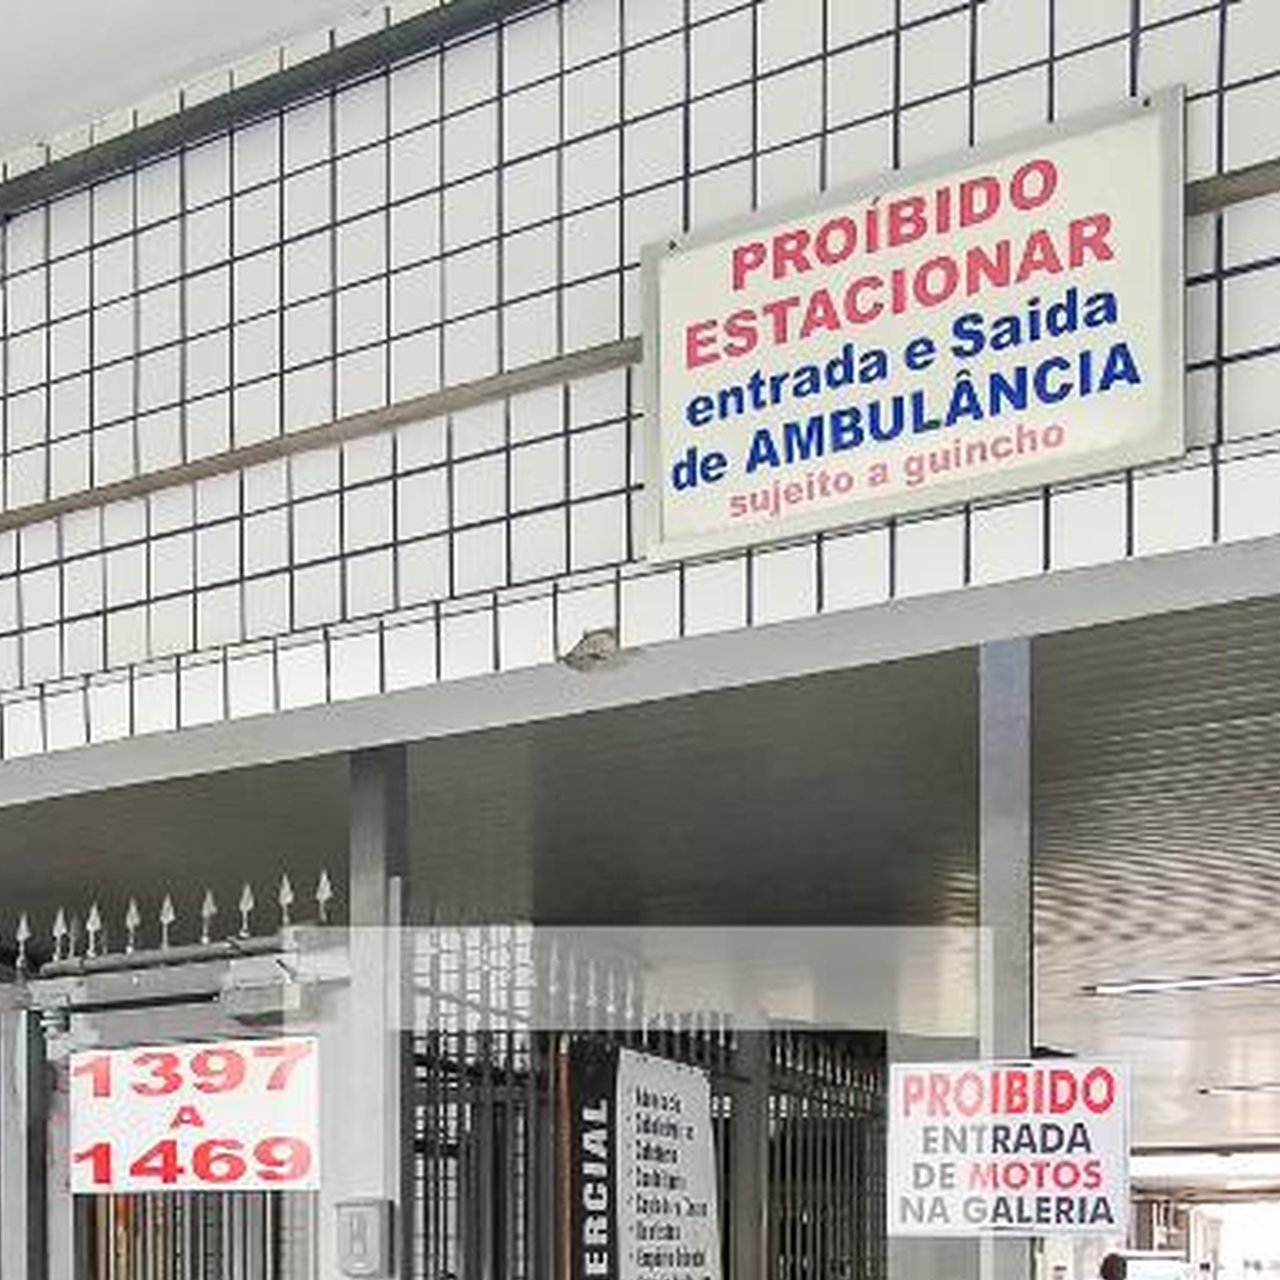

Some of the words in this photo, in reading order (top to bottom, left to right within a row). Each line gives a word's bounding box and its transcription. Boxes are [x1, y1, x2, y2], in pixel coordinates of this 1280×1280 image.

[731, 158, 1059, 290] PROÍBIDO
[684, 212, 1116, 368] ESTACIONAR
[685, 342, 888, 427] entrada
[904, 336, 937, 371] e
[950, 287, 1118, 358] Saida
[671, 447, 727, 491] de
[745, 342, 1142, 473] AMBULÂNCIA
[728, 458, 854, 519] sujeito
[866, 465, 890, 487] a
[903, 422, 1065, 486] guincho
[73, 1044, 313, 1098] 1397
[902, 1066, 1115, 1117] PROIBIDO
[170, 1105, 205, 1129] A
[922, 1122, 1091, 1154] ENTRADA
[73, 1136, 313, 1184] 1469
[913, 1162, 956, 1189] DE
[968, 1161, 1103, 1189] MOTOS
[900, 1197, 950, 1223] NA
[962, 1196, 1114, 1224] GALERIA
